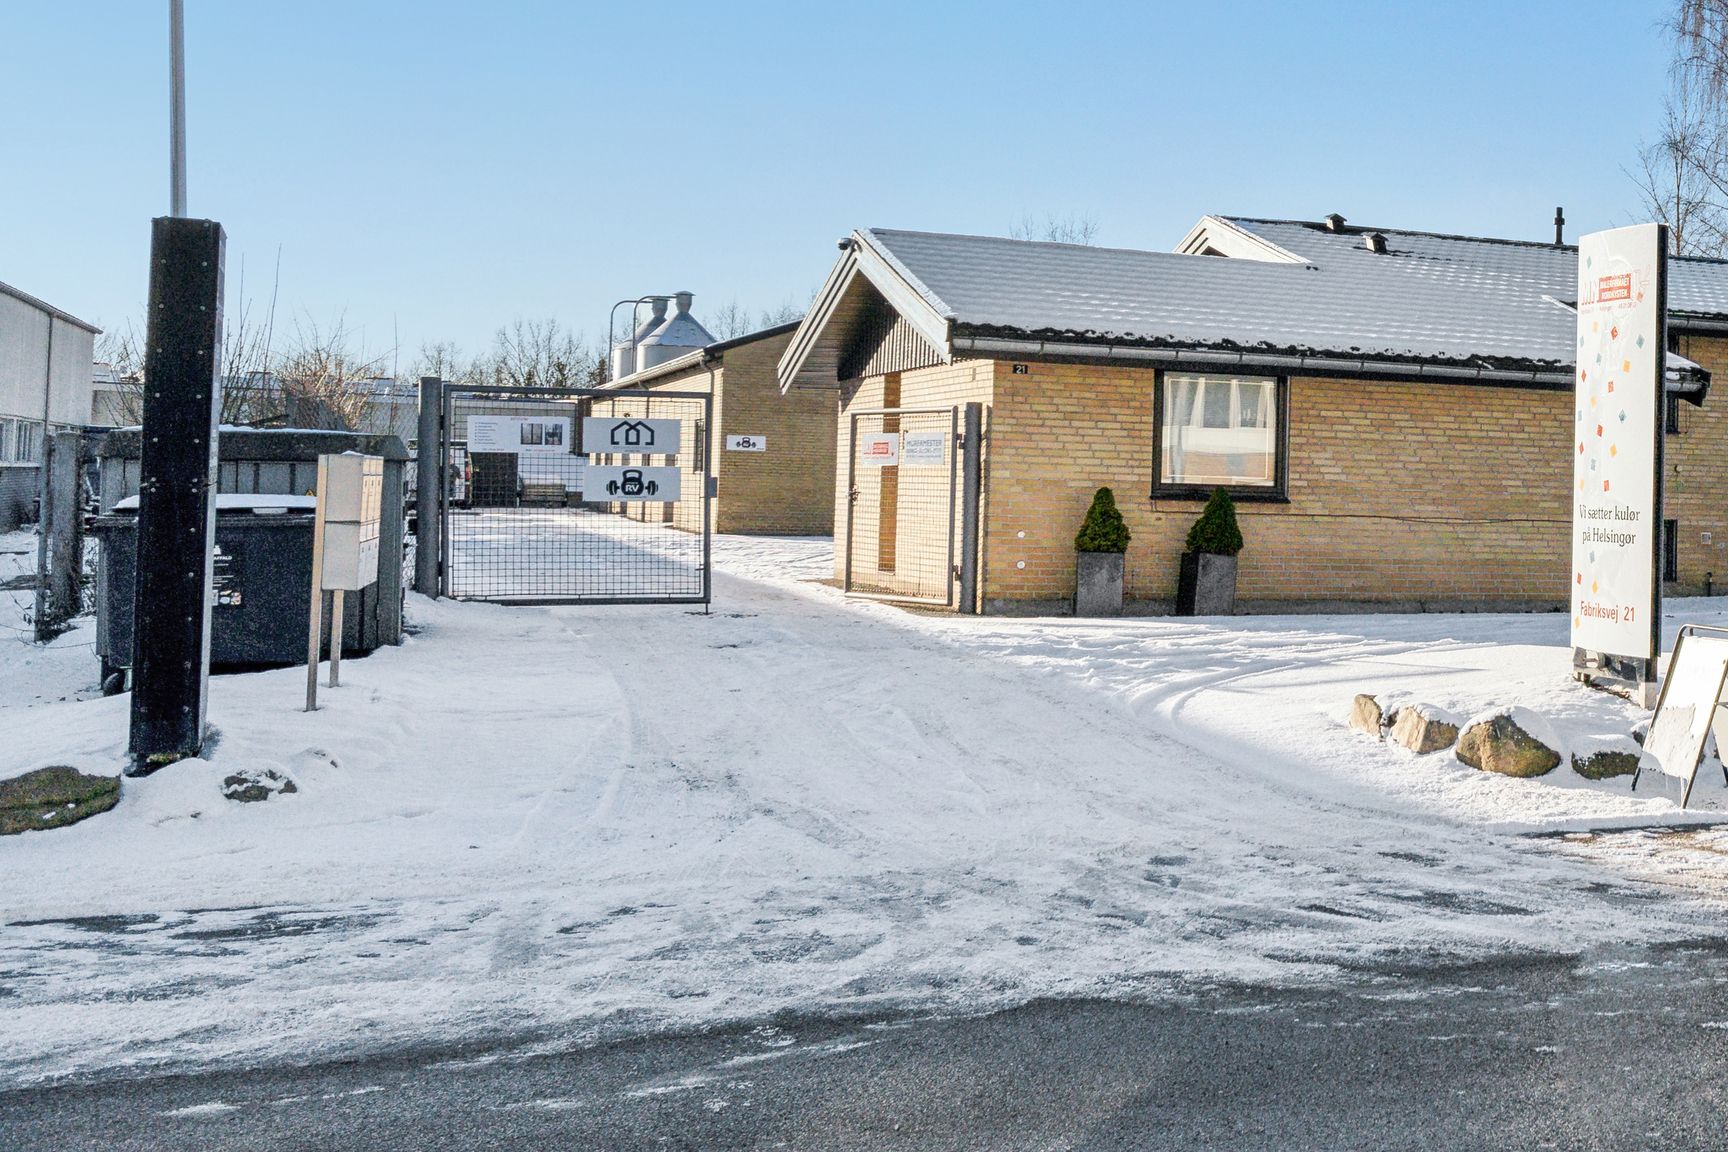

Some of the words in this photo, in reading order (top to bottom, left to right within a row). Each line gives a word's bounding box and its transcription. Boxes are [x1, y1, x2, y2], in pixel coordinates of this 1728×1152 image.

[1015, 365, 1026, 374] 21
[625, 484, 640, 492] RV
[1579, 504, 1587, 519] Vi
[1588, 508, 1612, 520] sætter
[1614, 505, 1641, 521] kulør
[1582, 526, 1591, 545] på
[1592, 527, 1637, 548] Helsingør
[1580, 600, 1619, 624] Fabriksvej
[1623, 606, 1635, 622] 21
